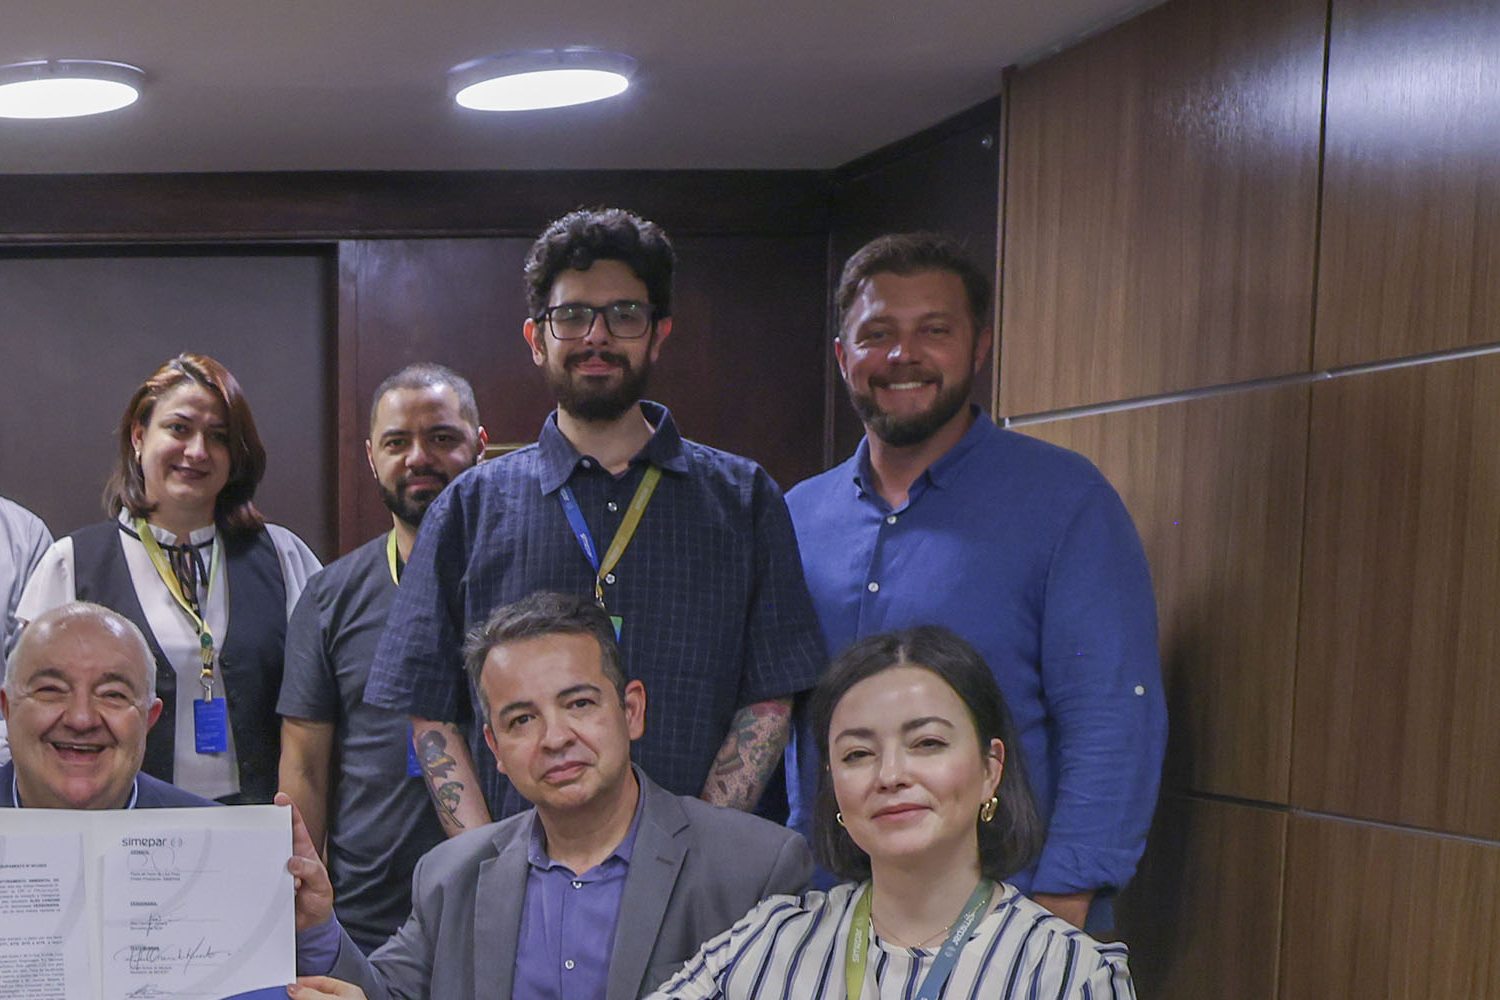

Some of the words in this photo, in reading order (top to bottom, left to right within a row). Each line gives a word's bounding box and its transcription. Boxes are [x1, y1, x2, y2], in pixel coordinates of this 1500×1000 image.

[121, 837, 167, 848] simepar
[852, 928, 863, 963] simepar
[952, 912, 975, 946] simepar
